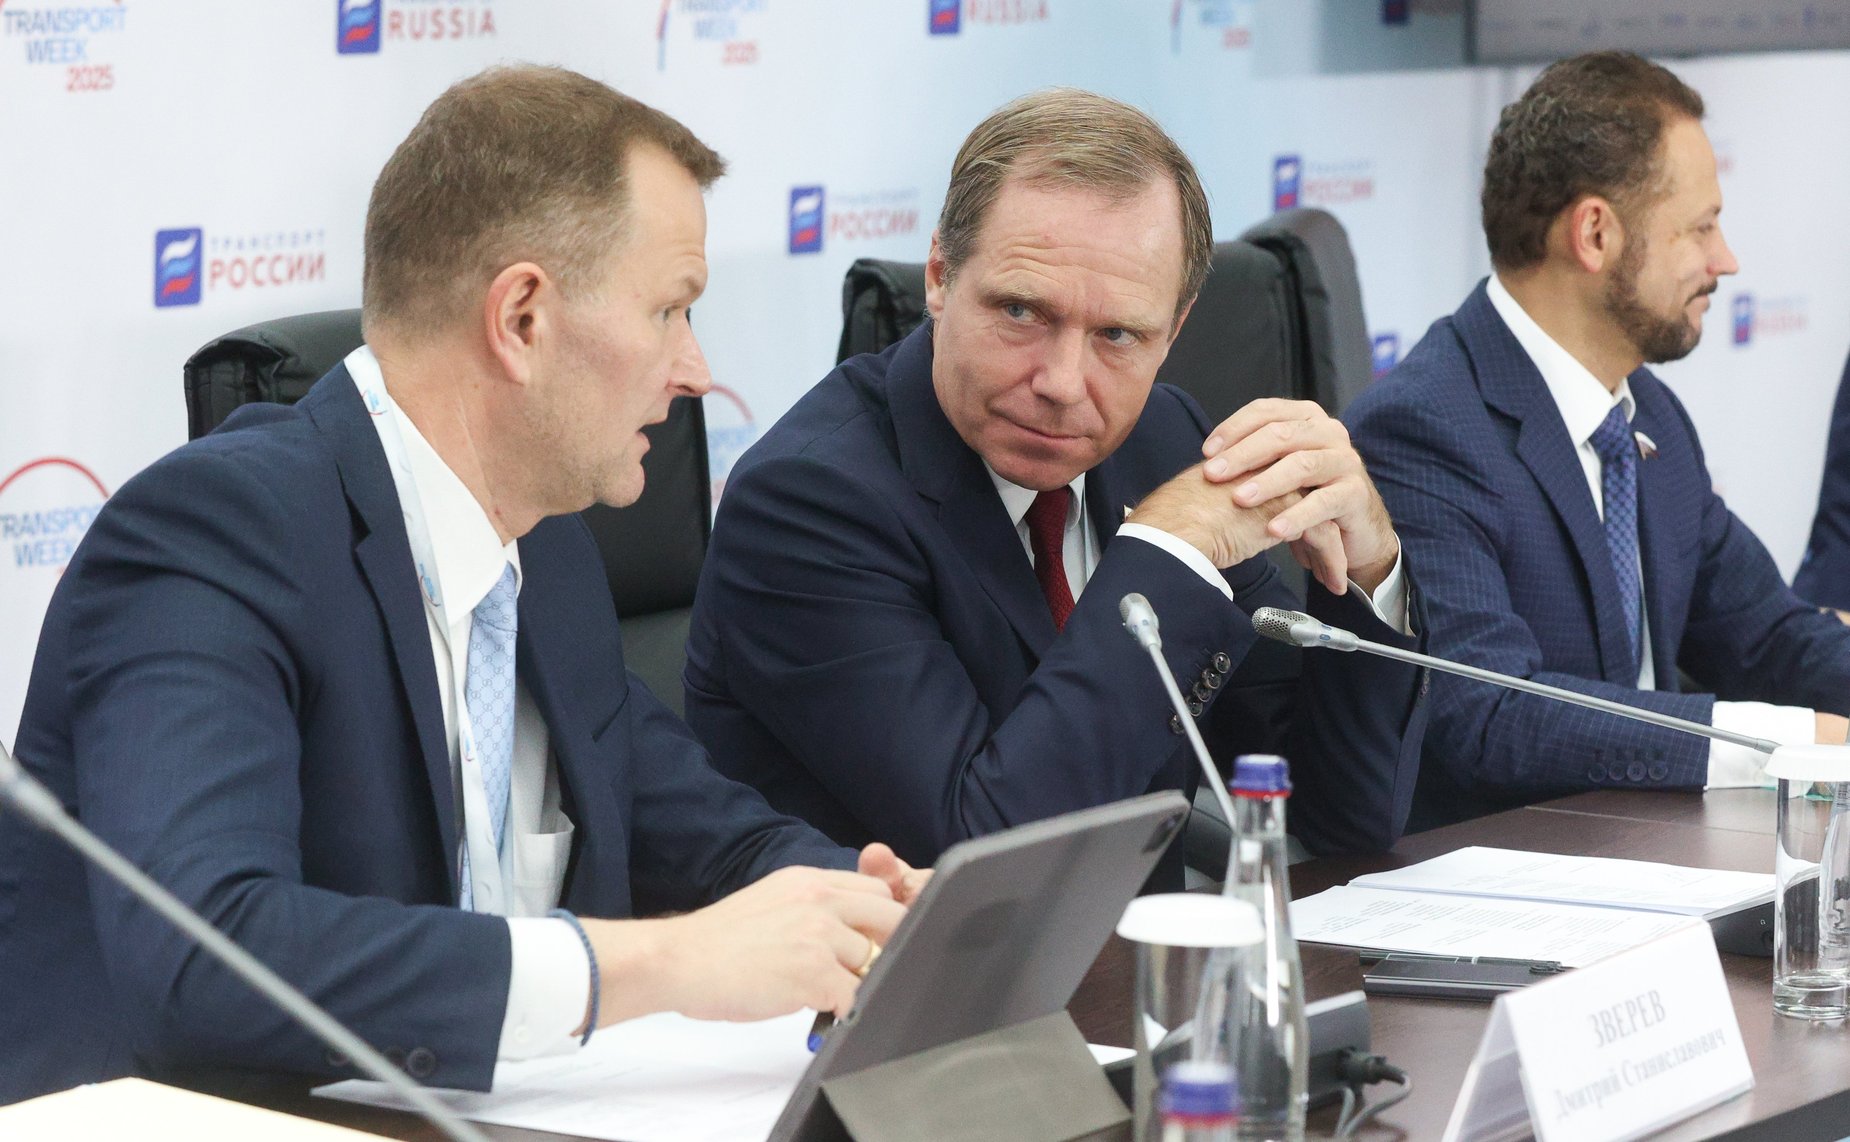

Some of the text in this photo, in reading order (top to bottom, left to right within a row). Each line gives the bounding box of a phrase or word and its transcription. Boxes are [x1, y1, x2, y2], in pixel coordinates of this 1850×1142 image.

[4, 7, 127, 35] TRANSPORT
[387, 8, 496, 40] RUSSIA
[26, 38, 88, 63] WEEK
[66, 64, 115, 91] 2025
[209, 253, 325, 290] РОССИИ
[1589, 989, 1666, 1048] ЗВЕРЕВ
[1554, 1028, 1727, 1121] Дмитрий Станиславович
